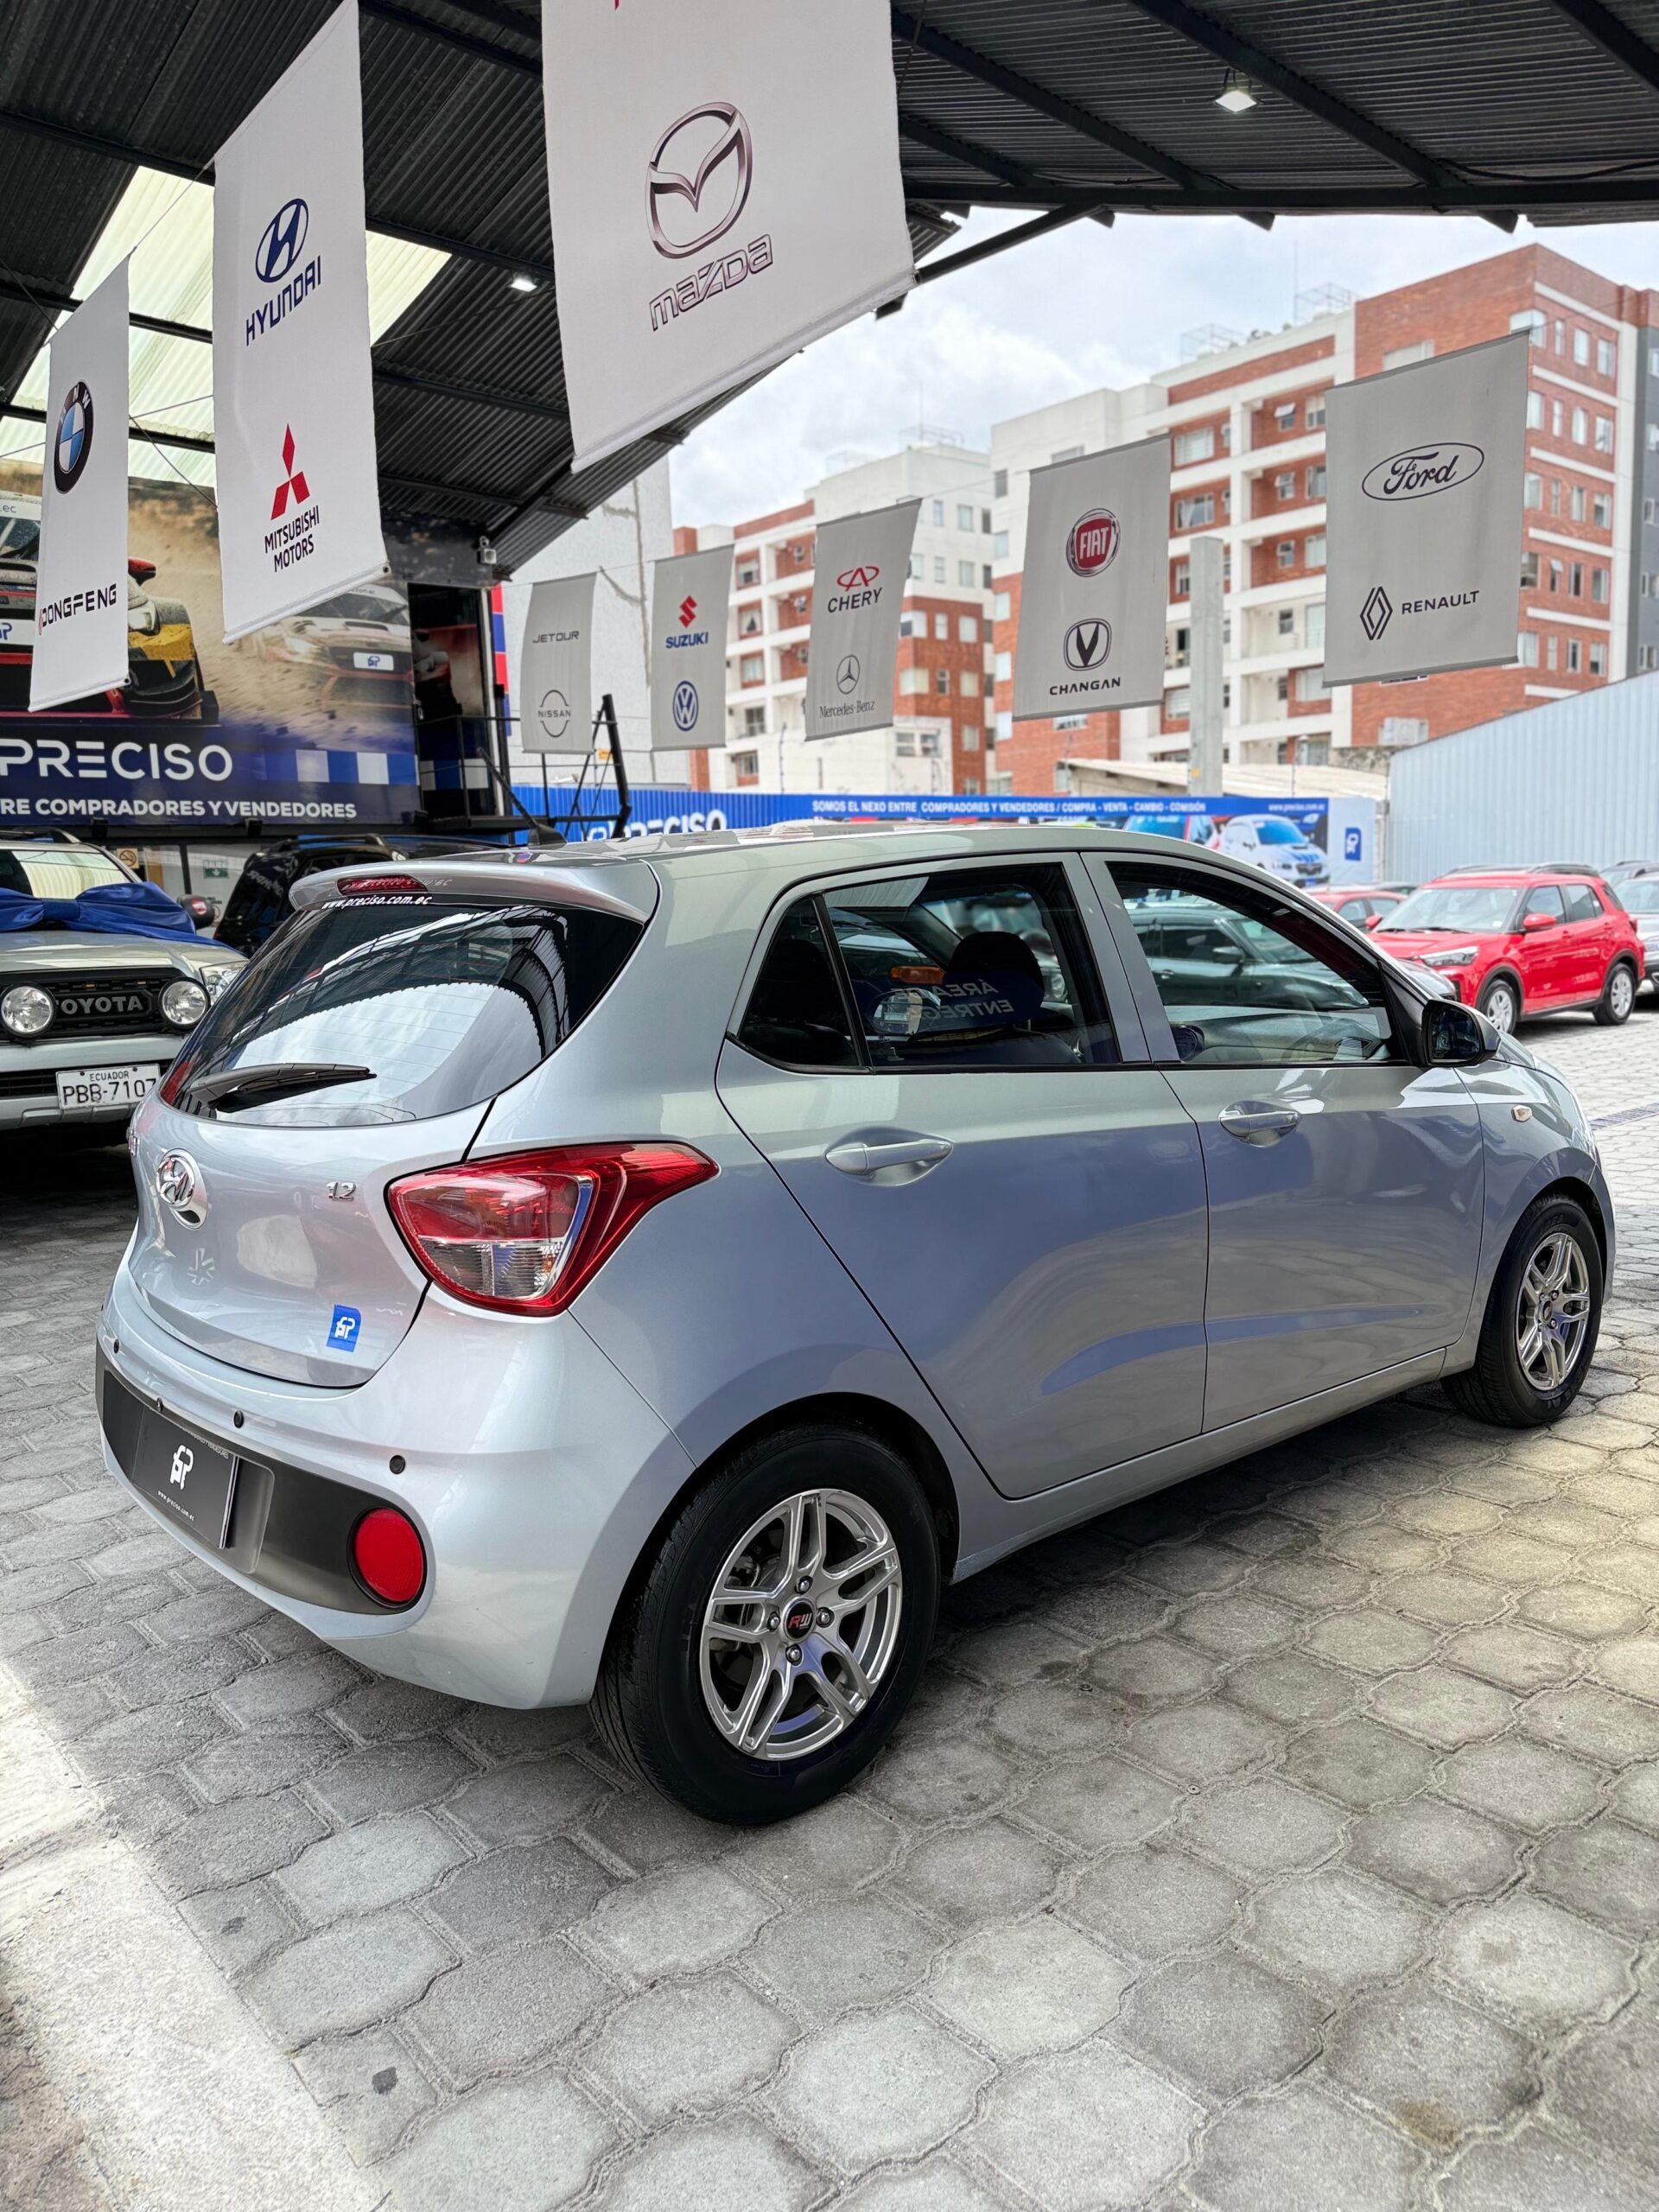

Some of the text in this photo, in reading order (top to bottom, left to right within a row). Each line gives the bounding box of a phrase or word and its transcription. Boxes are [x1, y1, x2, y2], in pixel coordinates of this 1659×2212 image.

[245, 255, 321, 346] HYUNDAI
[1382, 451, 1460, 495] Ford
[264, 504, 321, 554] MITSUBISHI
[273, 533, 315, 573] MOTORS
[1079, 526, 1109, 561] FIAT
[41, 582, 118, 628] DONGFENG
[827, 586, 883, 613] CHERY
[1401, 590, 1480, 615] RENAULT
[532, 630, 581, 644] JETOUR
[664, 631, 709, 649] SUZUKI
[1049, 676, 1122, 696] CHANGAN
[537, 709, 572, 719] NISSAN
[819, 698, 876, 720] Mercedes-Benz
[0, 738, 233, 782] PRECISO
[35, 798, 206, 817] COMPRADORES
[207, 800, 223, 816] Y
[223, 800, 357, 819] VENDEDORES
[812, 800, 846, 812] SOMOS
[848, 801, 860, 812] EL
[861, 801, 887, 812] NEXO
[887, 801, 917, 812] ENTRE
[921, 801, 989, 813] COMPRADORES
[990, 802, 997, 812] Y
[999, 802, 1055, 813] VENDEDORES
[1062, 802, 1096, 812] COMPRA
[1103, 802, 1128, 812] VENTA
[1134, 802, 1164, 812] CAMBIO
[321, 894, 433, 910] www.preciso.com.ec
[56, 995, 144, 1015] OYOTA
[89, 1071, 130, 1082] ECUADOR
[61, 1077, 157, 1106] PBB-7107
[158, 1491, 194, 1522] www.preciso.com.ec
